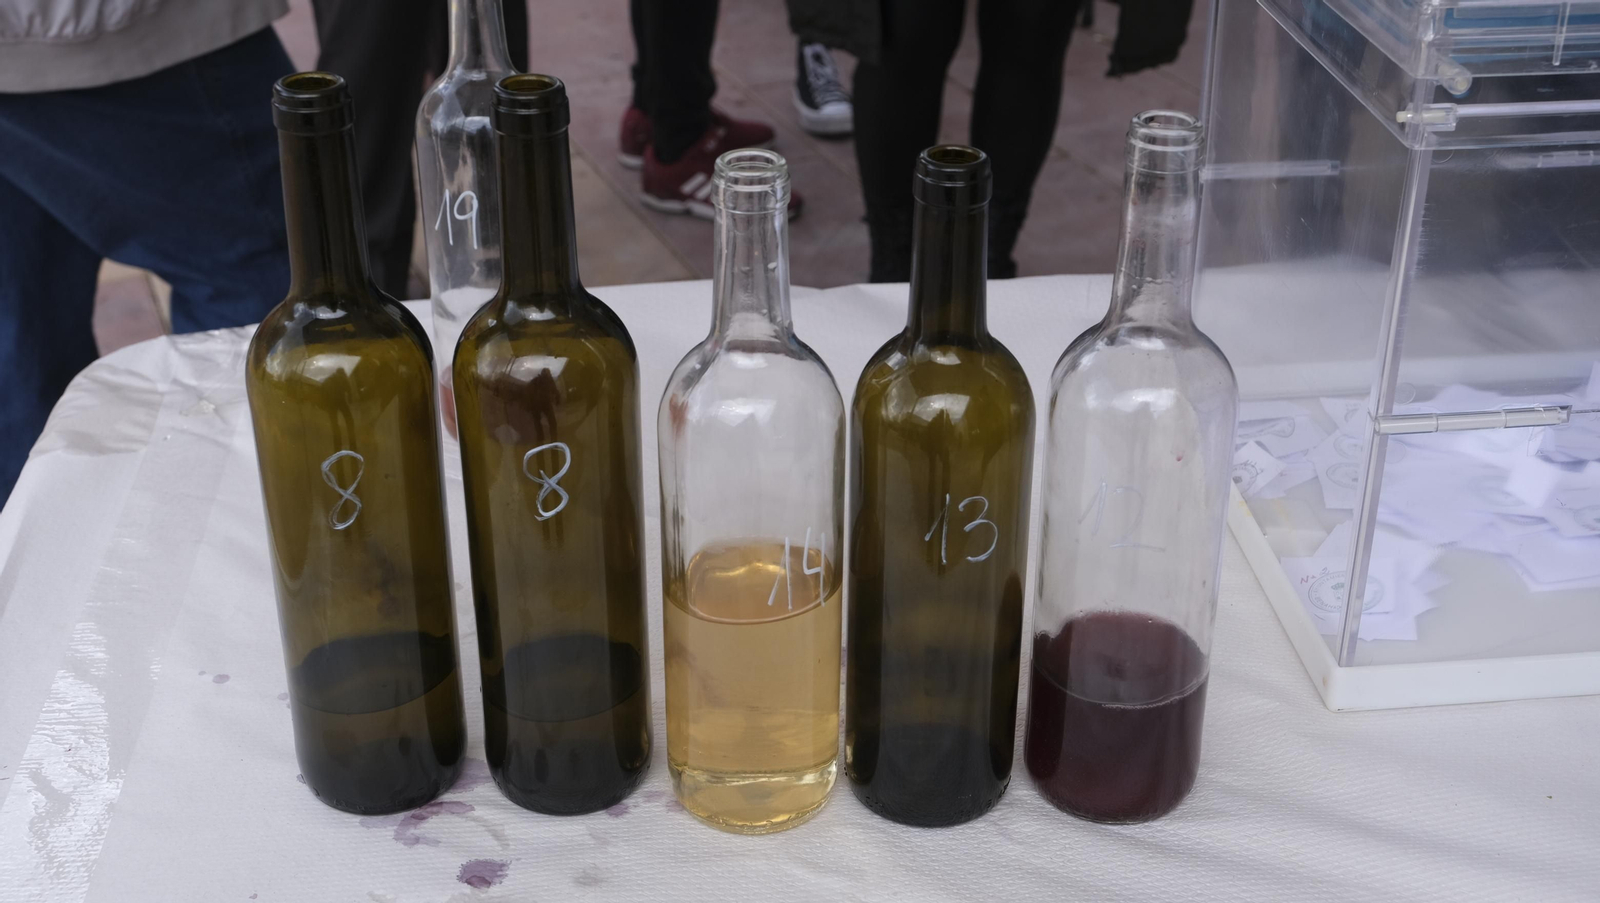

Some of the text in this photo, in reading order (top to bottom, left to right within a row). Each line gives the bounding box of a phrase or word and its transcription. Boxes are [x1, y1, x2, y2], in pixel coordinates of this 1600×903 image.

[434, 188, 479, 250] 19
[321, 450, 364, 530] 8
[523, 442, 571, 521] 8
[767, 526, 826, 610] 14
[924, 493, 998, 565] 13
